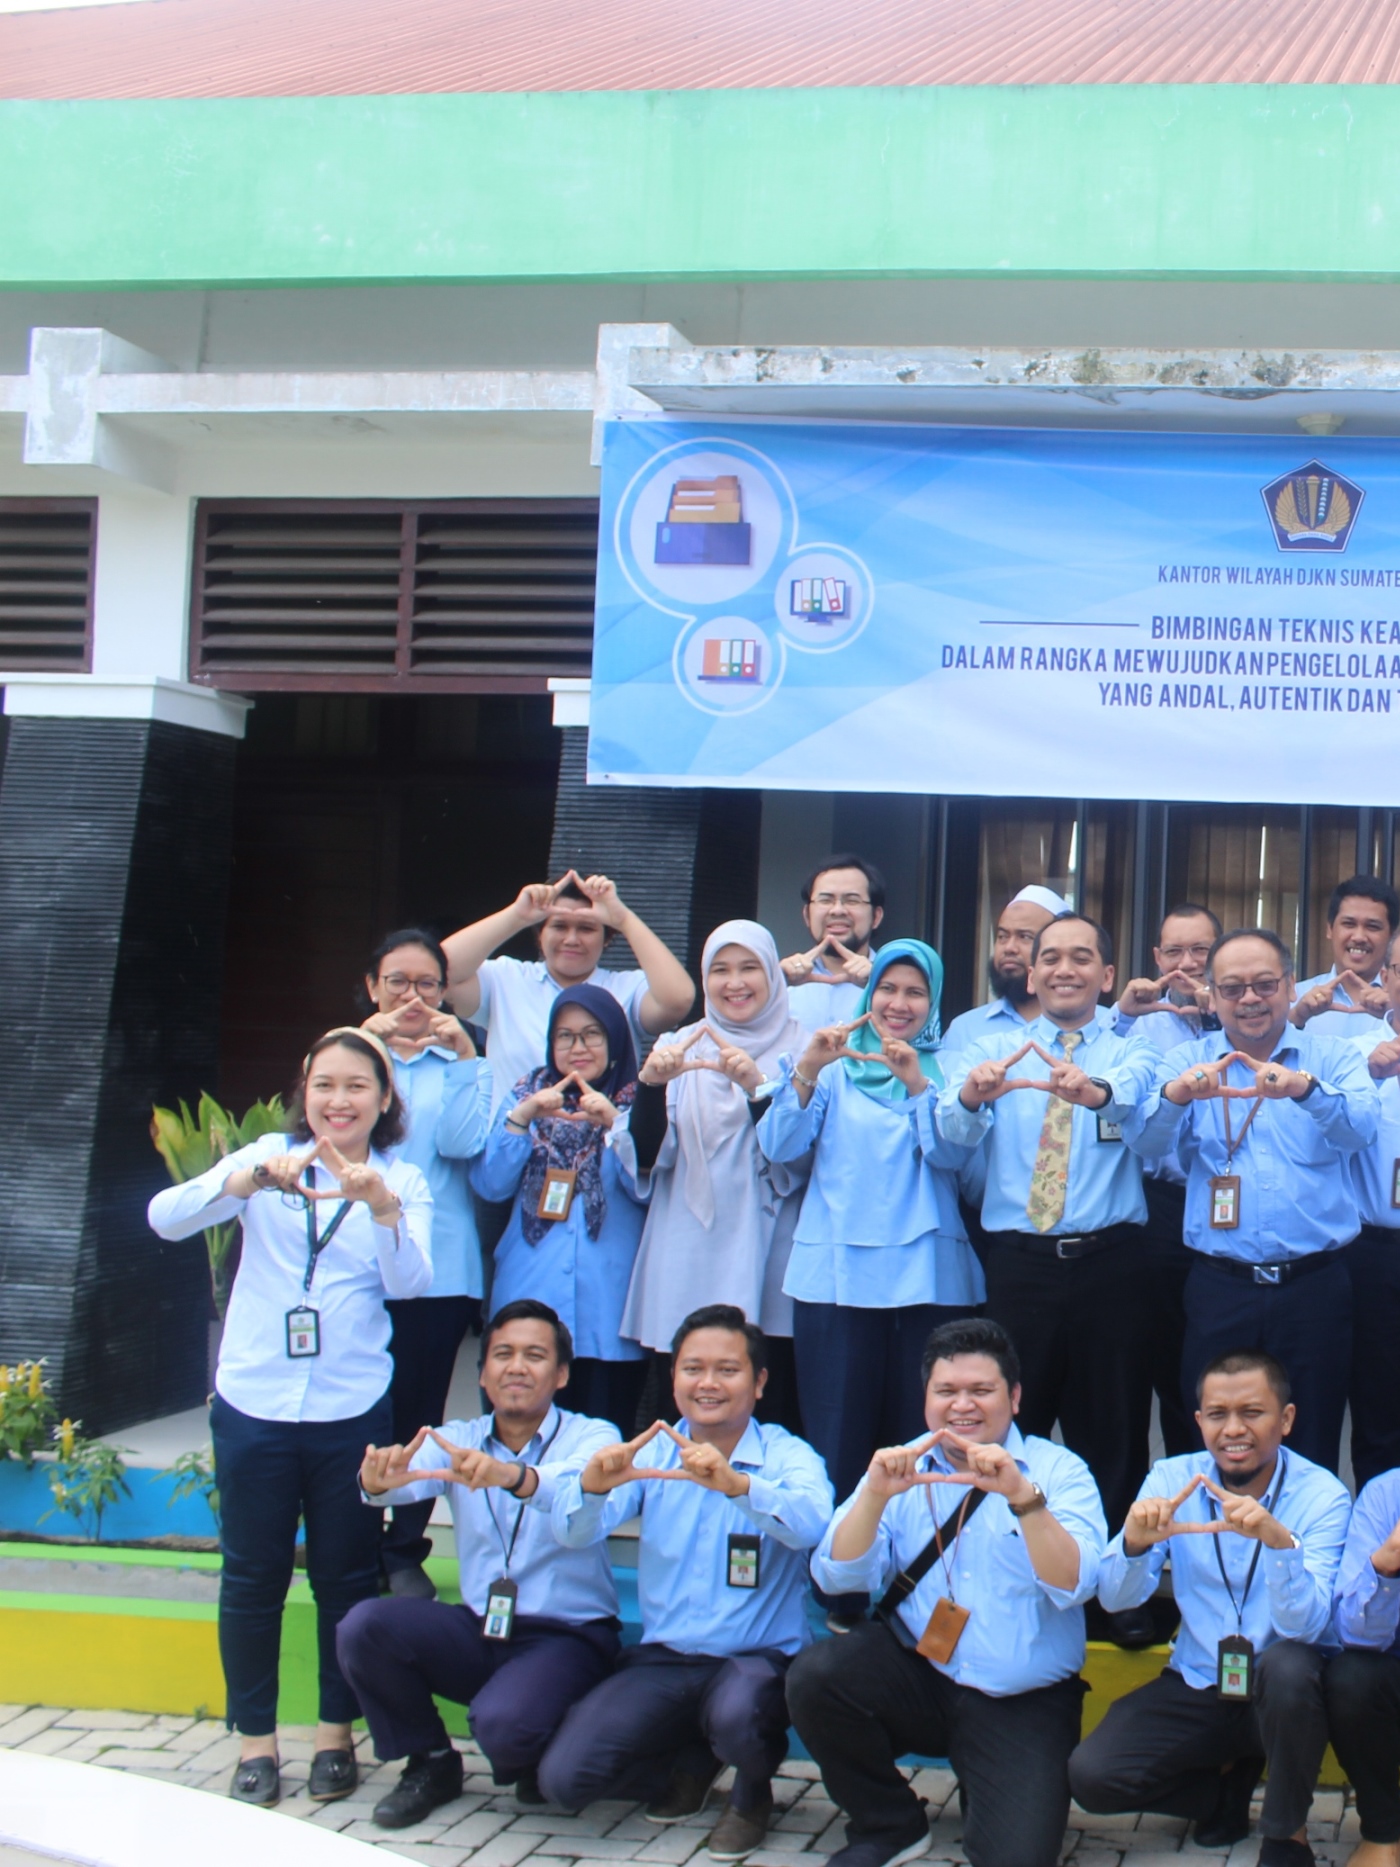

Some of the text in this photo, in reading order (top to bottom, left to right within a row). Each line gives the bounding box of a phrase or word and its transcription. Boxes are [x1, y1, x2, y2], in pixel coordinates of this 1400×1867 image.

[1158, 564, 1222, 584] KANTOR
[1226, 566, 1293, 586] WILAYAH
[1297, 567, 1337, 587] DJKN
[1151, 614, 1273, 643] BIMBINGAN
[1278, 617, 1355, 645] TEKNIS
[941, 644, 1015, 671] DALAM
[1020, 646, 1108, 673] RANGKA
[1098, 681, 1153, 708] YANG
[1158, 683, 1236, 712] ANDAL,
[1239, 685, 1344, 713] AUTENTIK
[1347, 687, 1392, 714] DAN
